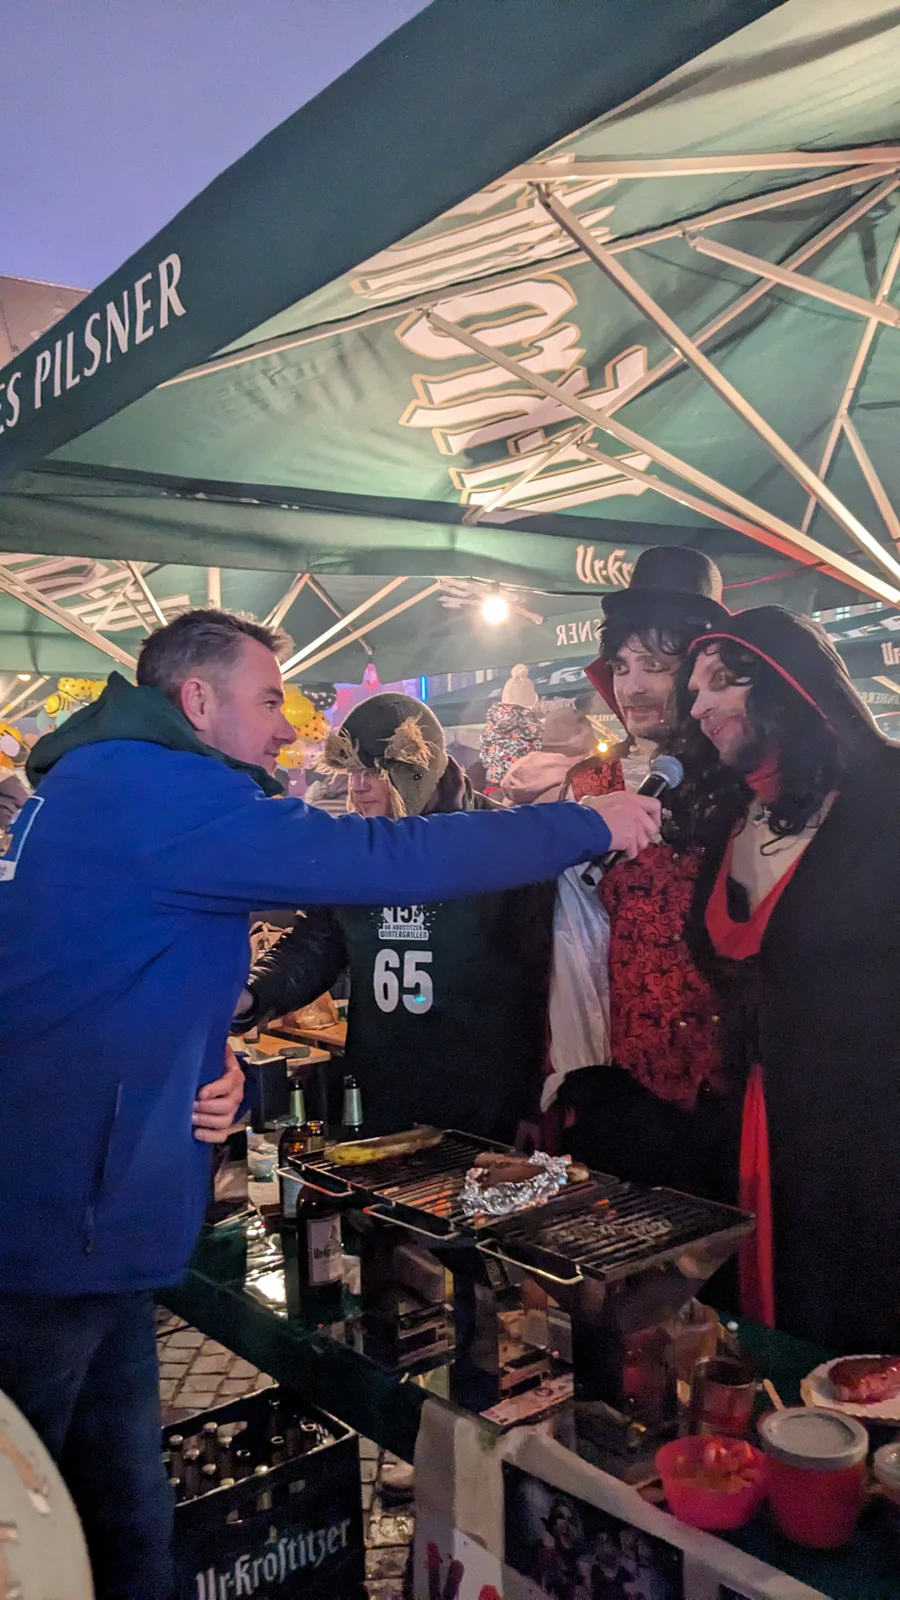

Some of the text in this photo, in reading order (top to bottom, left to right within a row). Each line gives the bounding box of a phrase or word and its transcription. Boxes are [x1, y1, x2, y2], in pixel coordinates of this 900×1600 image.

[0, 253, 187, 433] S PILSNER
[380, 930, 428, 939] WINTERGRILLEN
[373, 948, 433, 1014] 65
